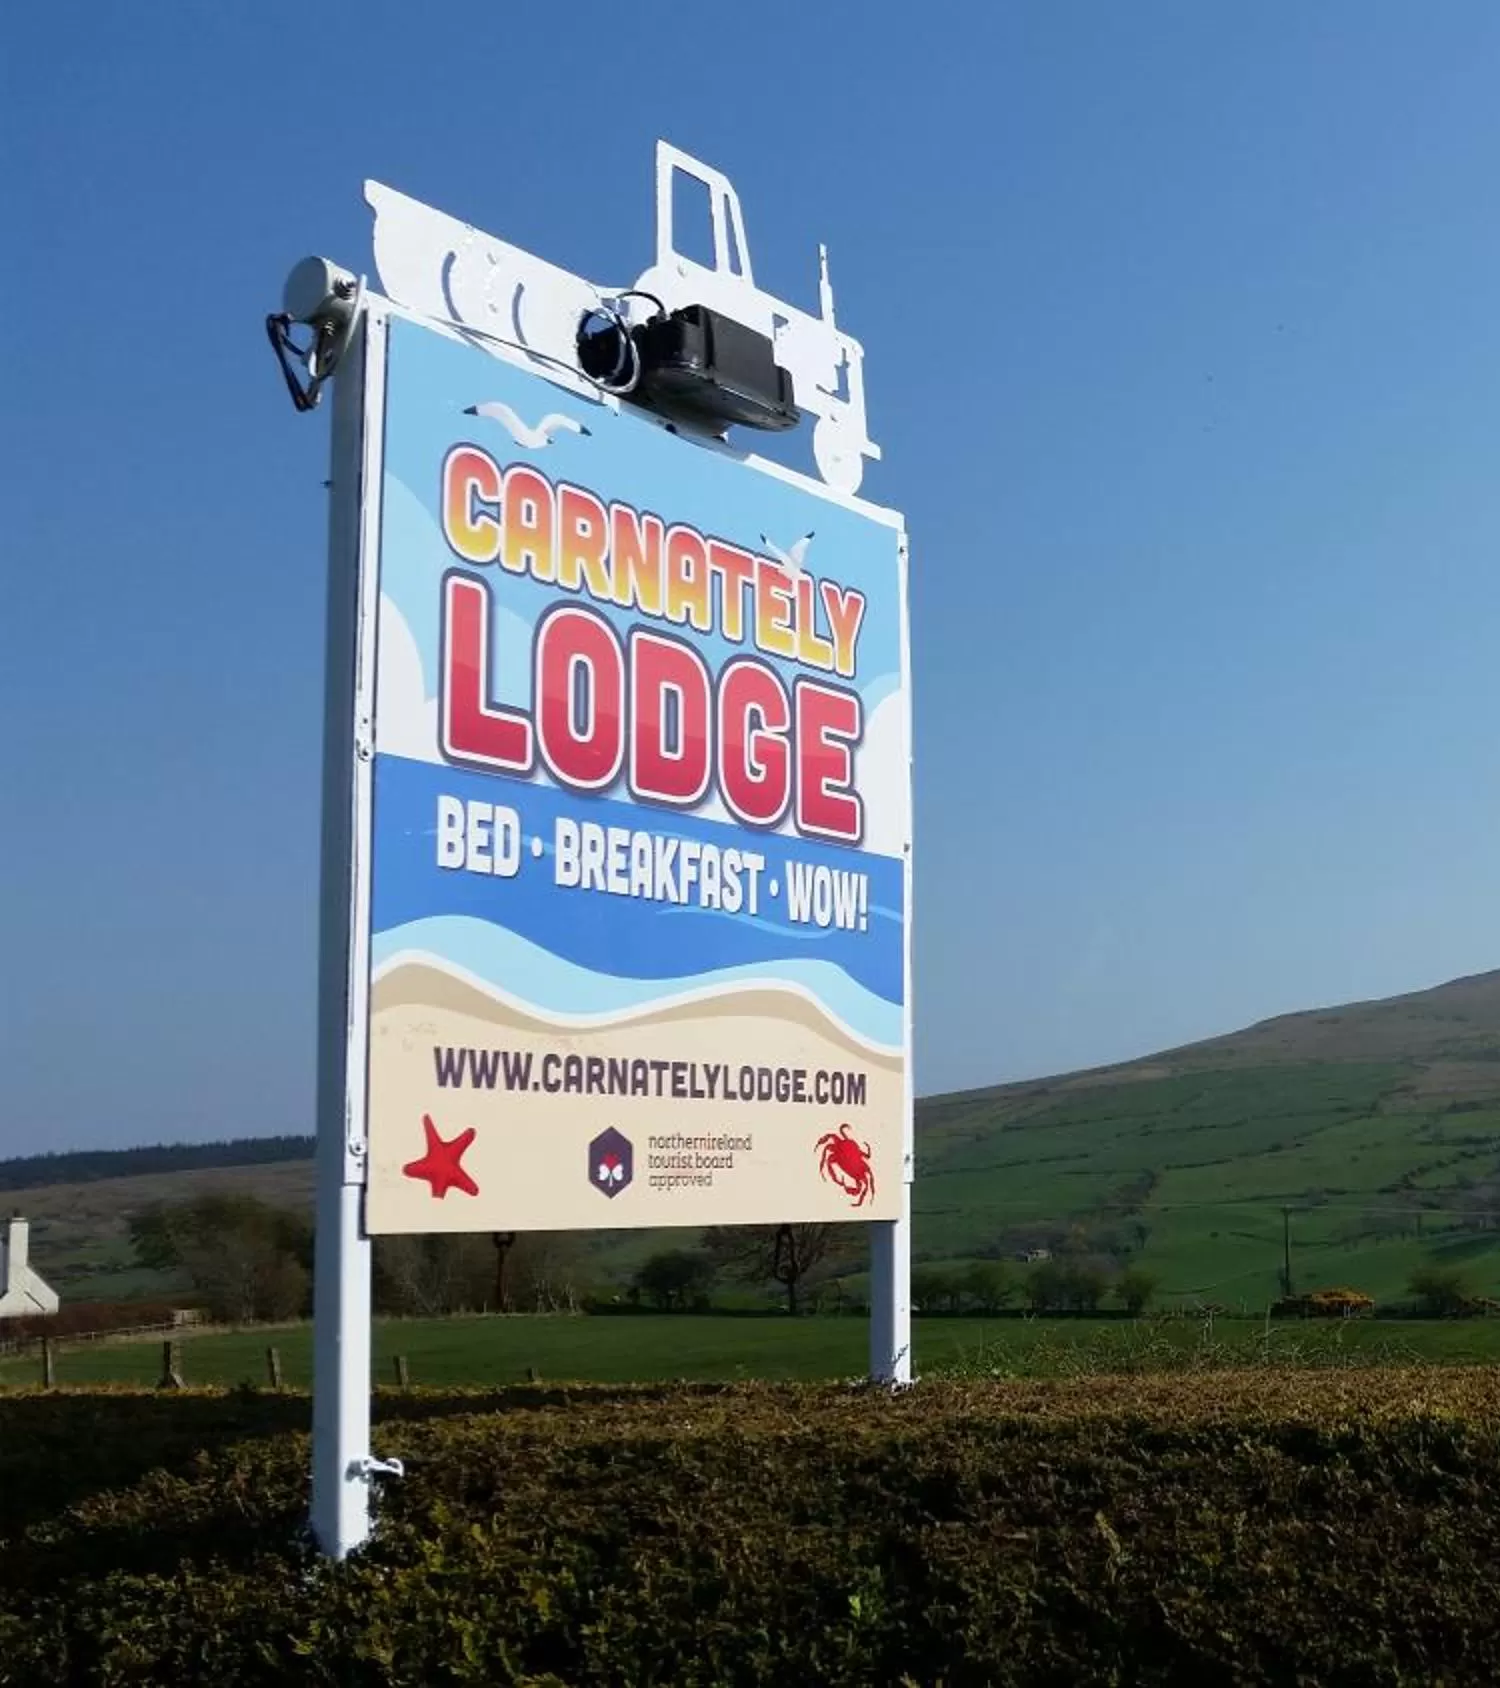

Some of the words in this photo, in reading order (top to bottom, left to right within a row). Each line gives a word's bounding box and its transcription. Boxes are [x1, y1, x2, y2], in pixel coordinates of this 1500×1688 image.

[441, 443, 867, 679] CARNATELY
[438, 569, 863, 847] LODGE
[437, 794, 520, 878] BED
[554, 816, 765, 915] BREAKFAST
[785, 859, 868, 931] WOW!
[434, 1045, 867, 1105] WWW.CARNATELYLODGE.COM
[648, 1152, 693, 1169] tourist
[695, 1153, 733, 1169] board
[648, 1172, 713, 1191] approved
